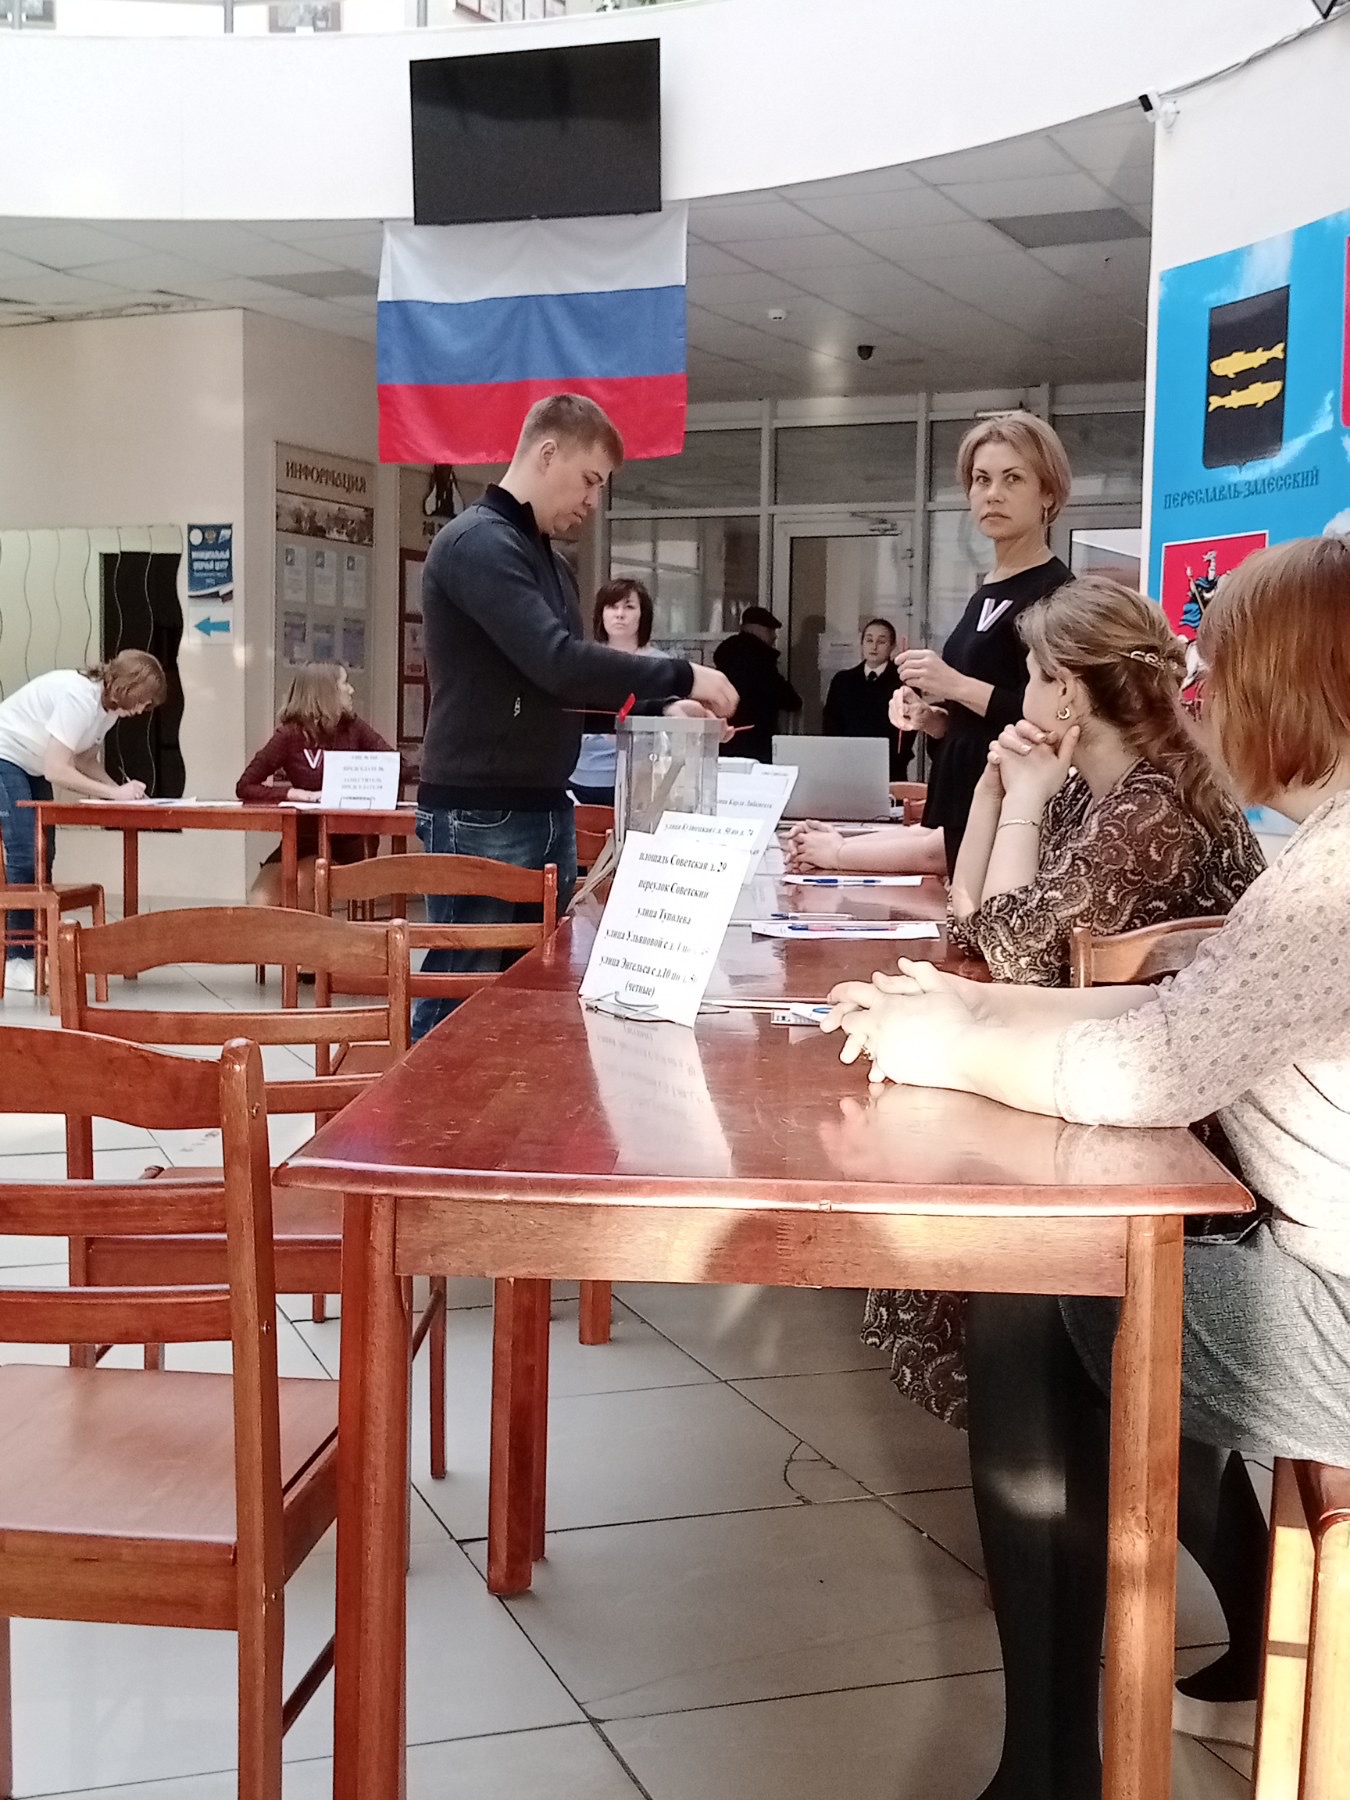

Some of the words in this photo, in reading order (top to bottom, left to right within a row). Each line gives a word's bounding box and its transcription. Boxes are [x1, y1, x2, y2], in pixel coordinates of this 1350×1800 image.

[285, 461, 366, 494] ИНФОРМАЦИЯ
[1163, 466, 1320, 510] ПЕРЕСЛАВЛЬ-ЗАЛЕССКИЙ
[639, 852, 668, 864] площадь
[670, 854, 708, 870] Советская
[638, 880, 670, 892] переулок
[636, 907, 657, 918] улица
[659, 908, 691, 925] Туполева
[604, 929, 625, 939] улица
[599, 956, 620, 967] улица
[620, 957, 651, 974] Энгельса
[625, 980, 655, 998] (четные)
